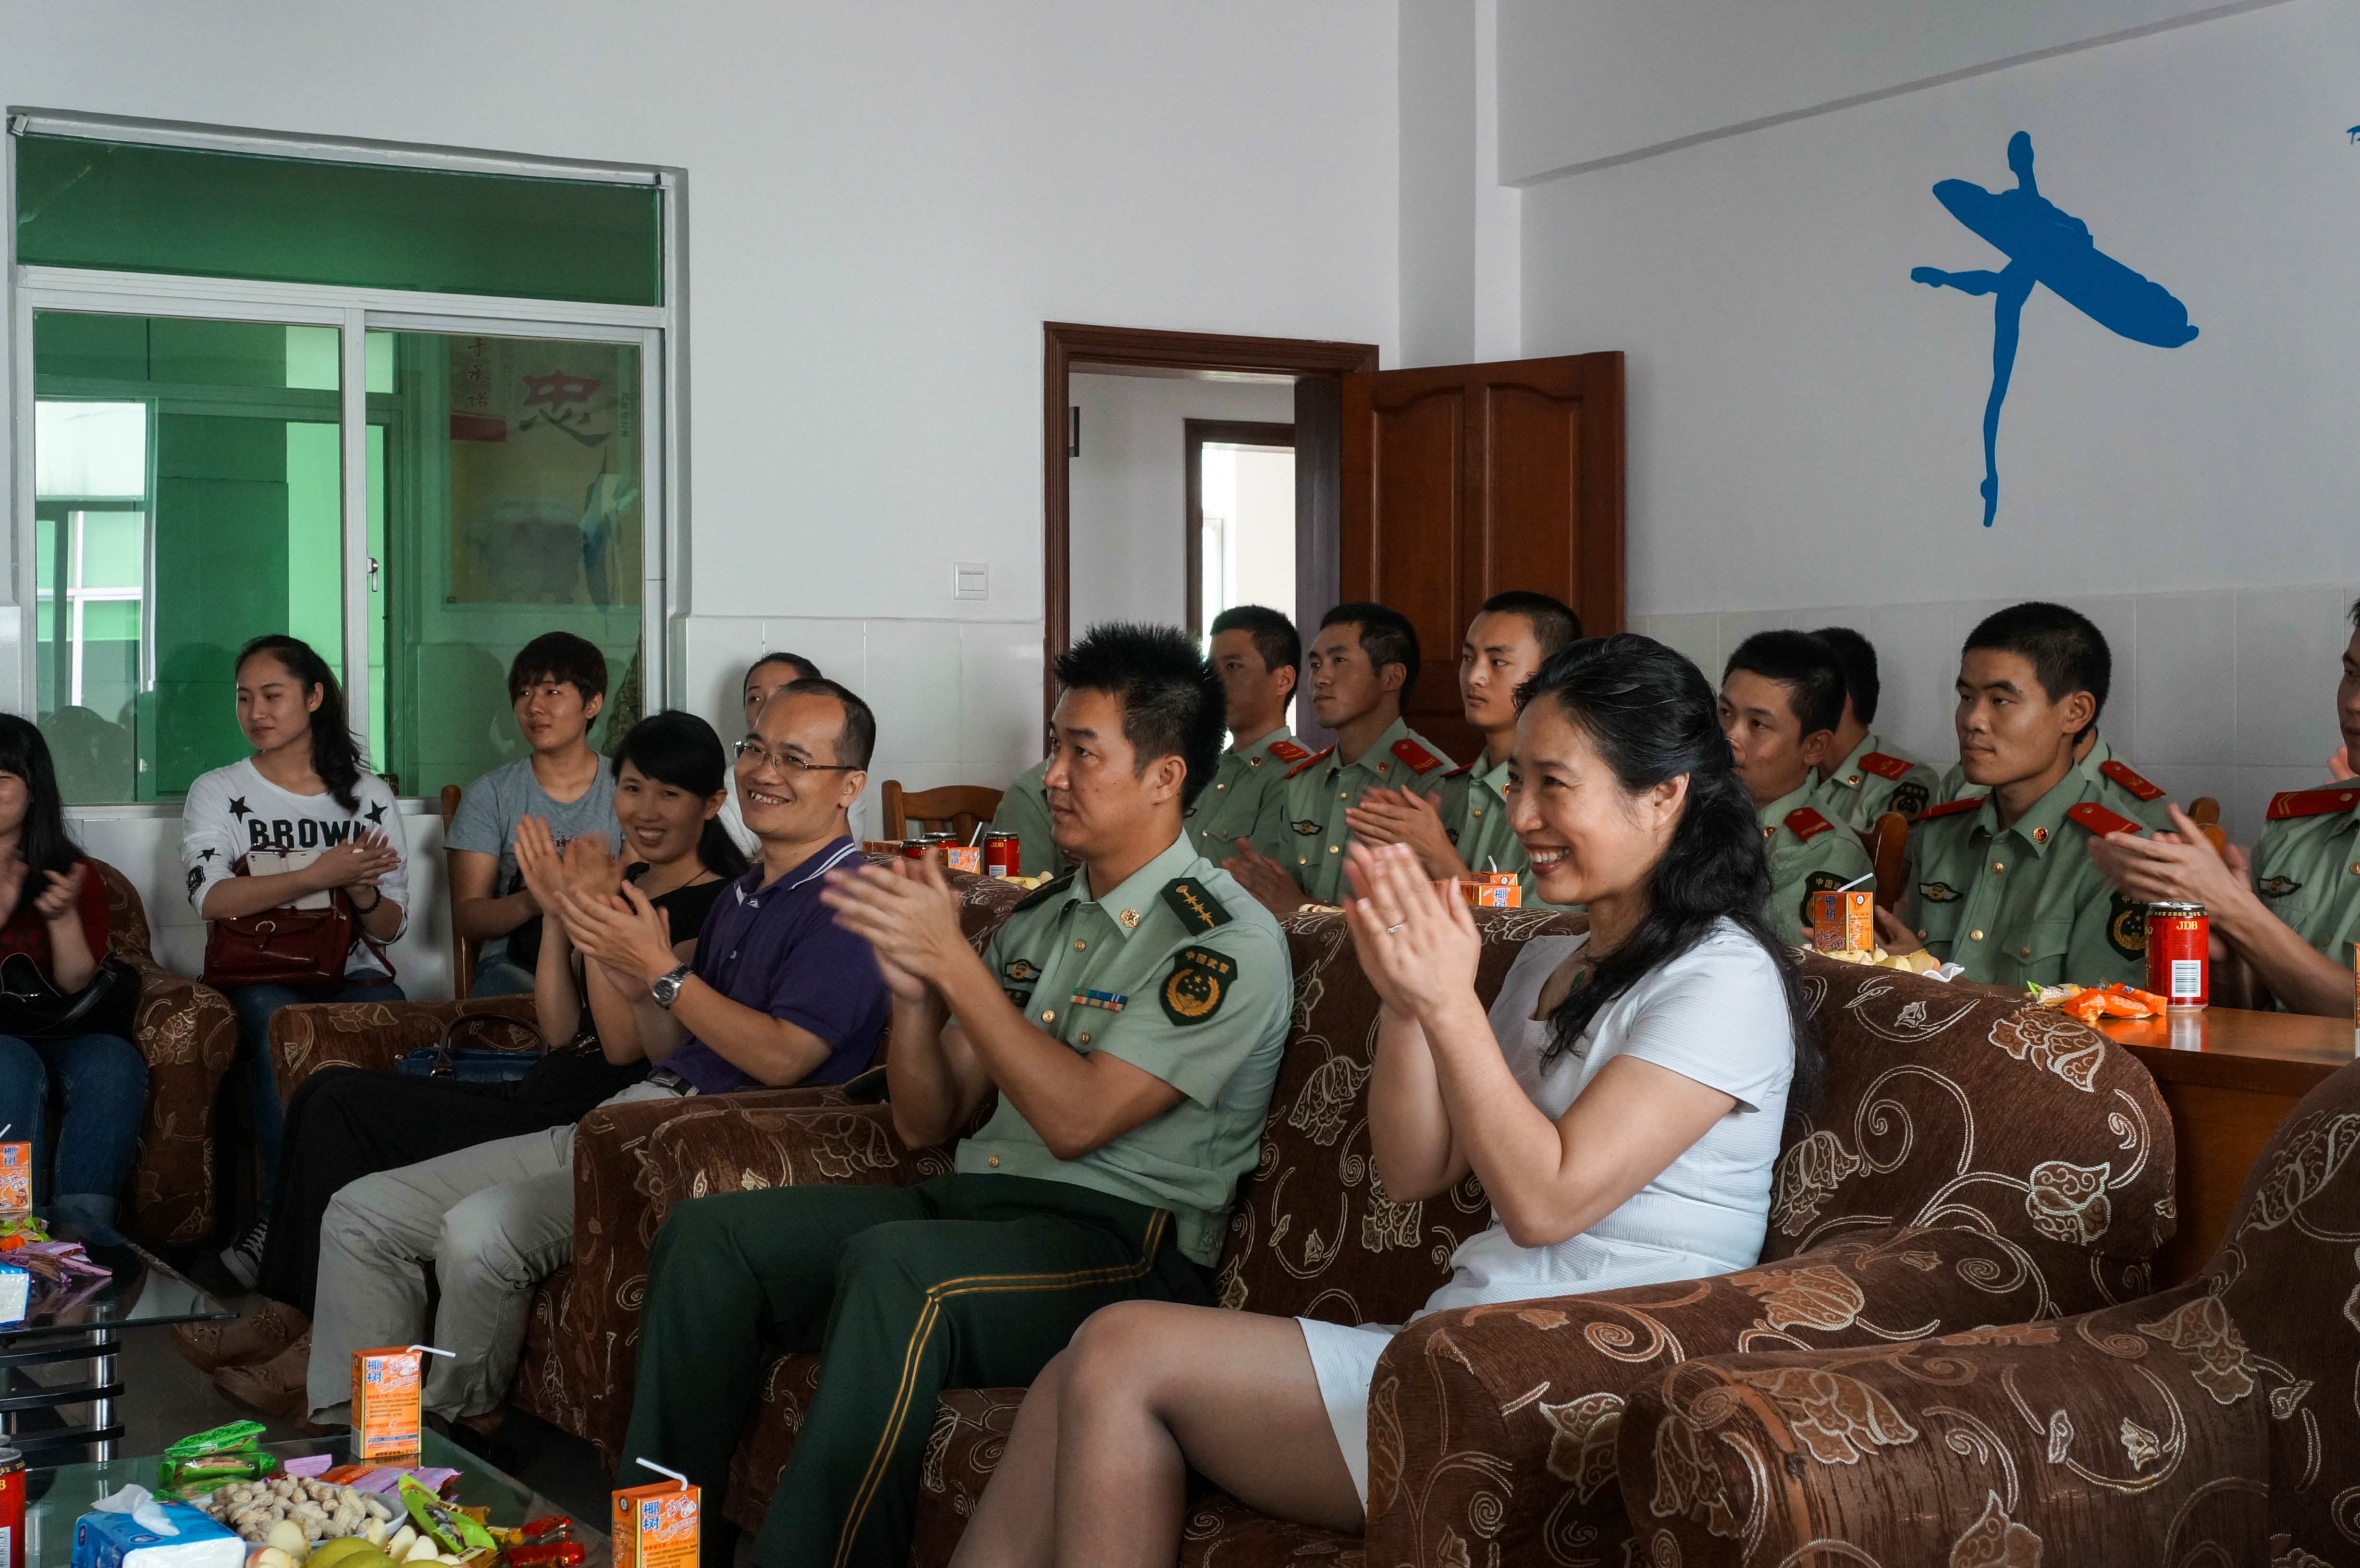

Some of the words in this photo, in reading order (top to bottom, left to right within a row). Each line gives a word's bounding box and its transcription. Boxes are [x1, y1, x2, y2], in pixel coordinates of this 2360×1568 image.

[520, 370, 610, 447] 忠
[1816, 878, 1842, 889] 中国武
[2176, 921, 2198, 930] JDB
[367, 1360, 382, 1383] 椰树
[643, 1501, 660, 1531] 椰树
